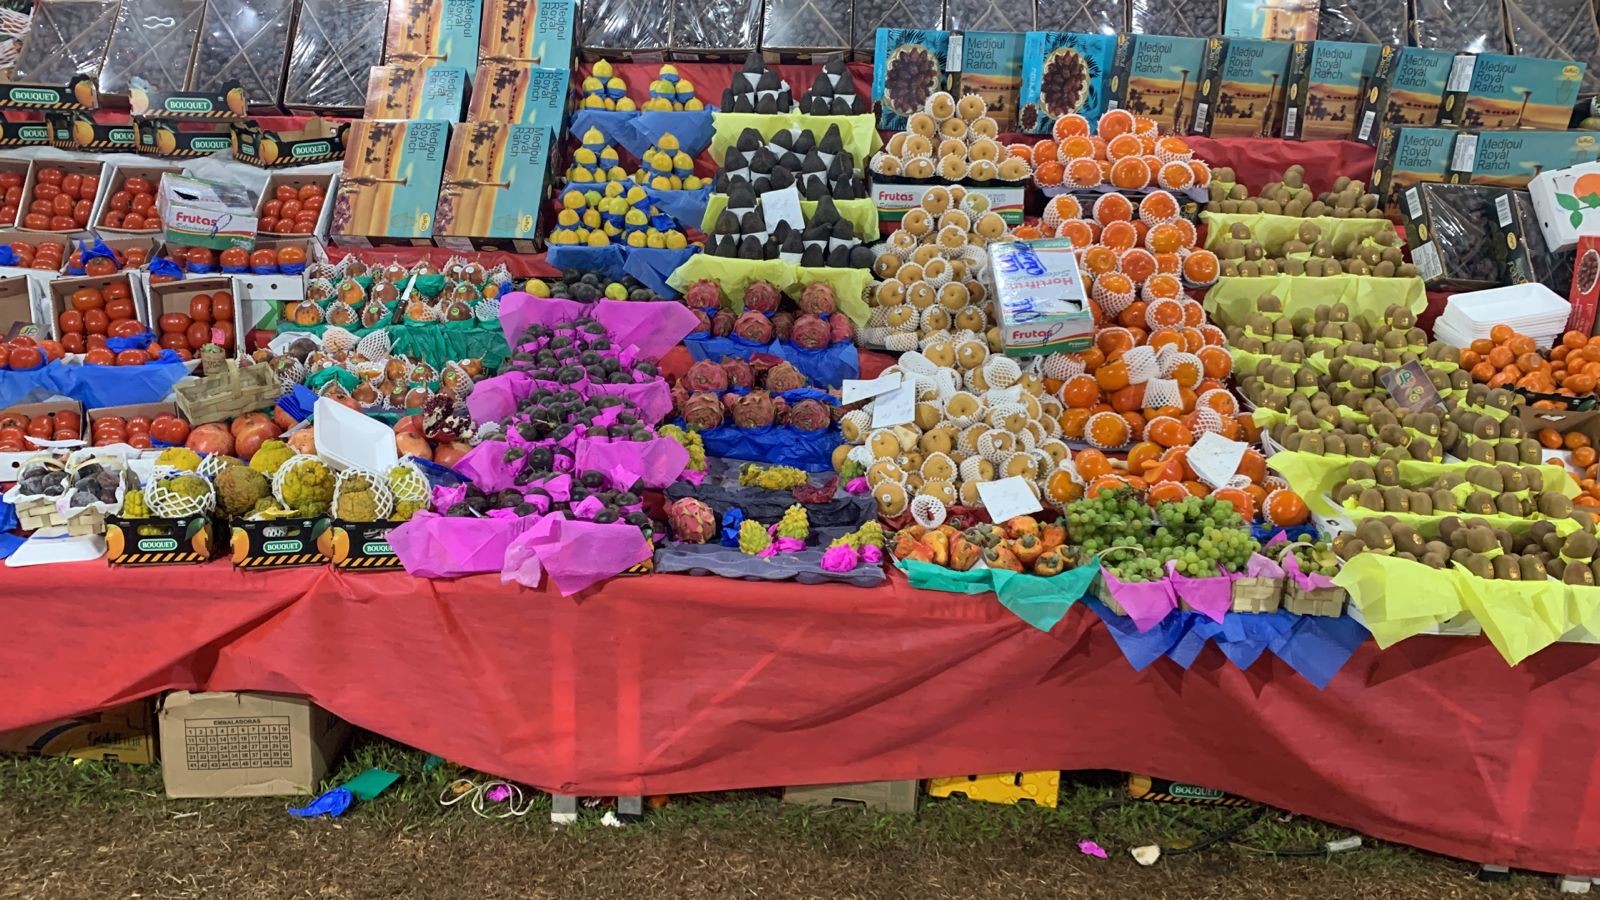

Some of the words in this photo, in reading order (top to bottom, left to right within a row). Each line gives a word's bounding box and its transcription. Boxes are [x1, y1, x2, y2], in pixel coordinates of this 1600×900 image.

[539, 2, 551, 34] Ranch
[548, 2, 560, 31] Royal
[557, 2, 568, 41] Medjoul
[967, 37, 1006, 51] Medjoul
[1138, 41, 1173, 54] Medjoul
[967, 48, 995, 61] Royal
[1137, 52, 1162, 64] Royal
[1231, 45, 1264, 59] Medjoul
[1317, 47, 1353, 60] Medjoul
[966, 58, 998, 70] Ranch
[1229, 56, 1253, 68] Royal
[1316, 57, 1342, 70] Royal
[1404, 54, 1440, 68] Medjoul
[1480, 61, 1517, 74] Medjoul
[1134, 63, 1163, 74] Ranch
[1226, 67, 1253, 78] Ranch
[1314, 68, 1343, 80] Ranch
[1401, 65, 1427, 78] Royal
[1398, 75, 1427, 88] Ranch
[1477, 71, 1505, 84] Royal
[531, 71, 545, 102] Ranch
[541, 72, 554, 99] Royal
[549, 73, 564, 109] Medjoul
[1473, 81, 1505, 94] Ranch
[15, 92, 54, 101] BOUQUET
[170, 101, 208, 110] BOUQUET
[23, 129, 48, 138] BOUQU
[113, 132, 135, 141] BOUQ
[407, 122, 421, 154] Ranch
[418, 122, 432, 151] Royal
[195, 141, 229, 149] BOUQUET
[426, 122, 442, 162] Medjoul
[510, 127, 525, 158] Ranch
[520, 127, 535, 154] Royal
[529, 127, 545, 165] Medjoul
[1403, 135, 1444, 150] Medjoul
[1482, 138, 1523, 154] Medjoul
[295, 144, 327, 156] BOUQUET
[1402, 145, 1431, 158] Royal
[1479, 149, 1510, 162] Royal
[1400, 155, 1432, 168] Ranch
[1477, 159, 1511, 170] Ranch
[879, 191, 914, 202] Frutas
[176, 212, 217, 226] Frutas
[1013, 330, 1054, 340] Frutas
[142, 541, 174, 550] BOUQUET
[267, 543, 299, 552] BOUQUET
